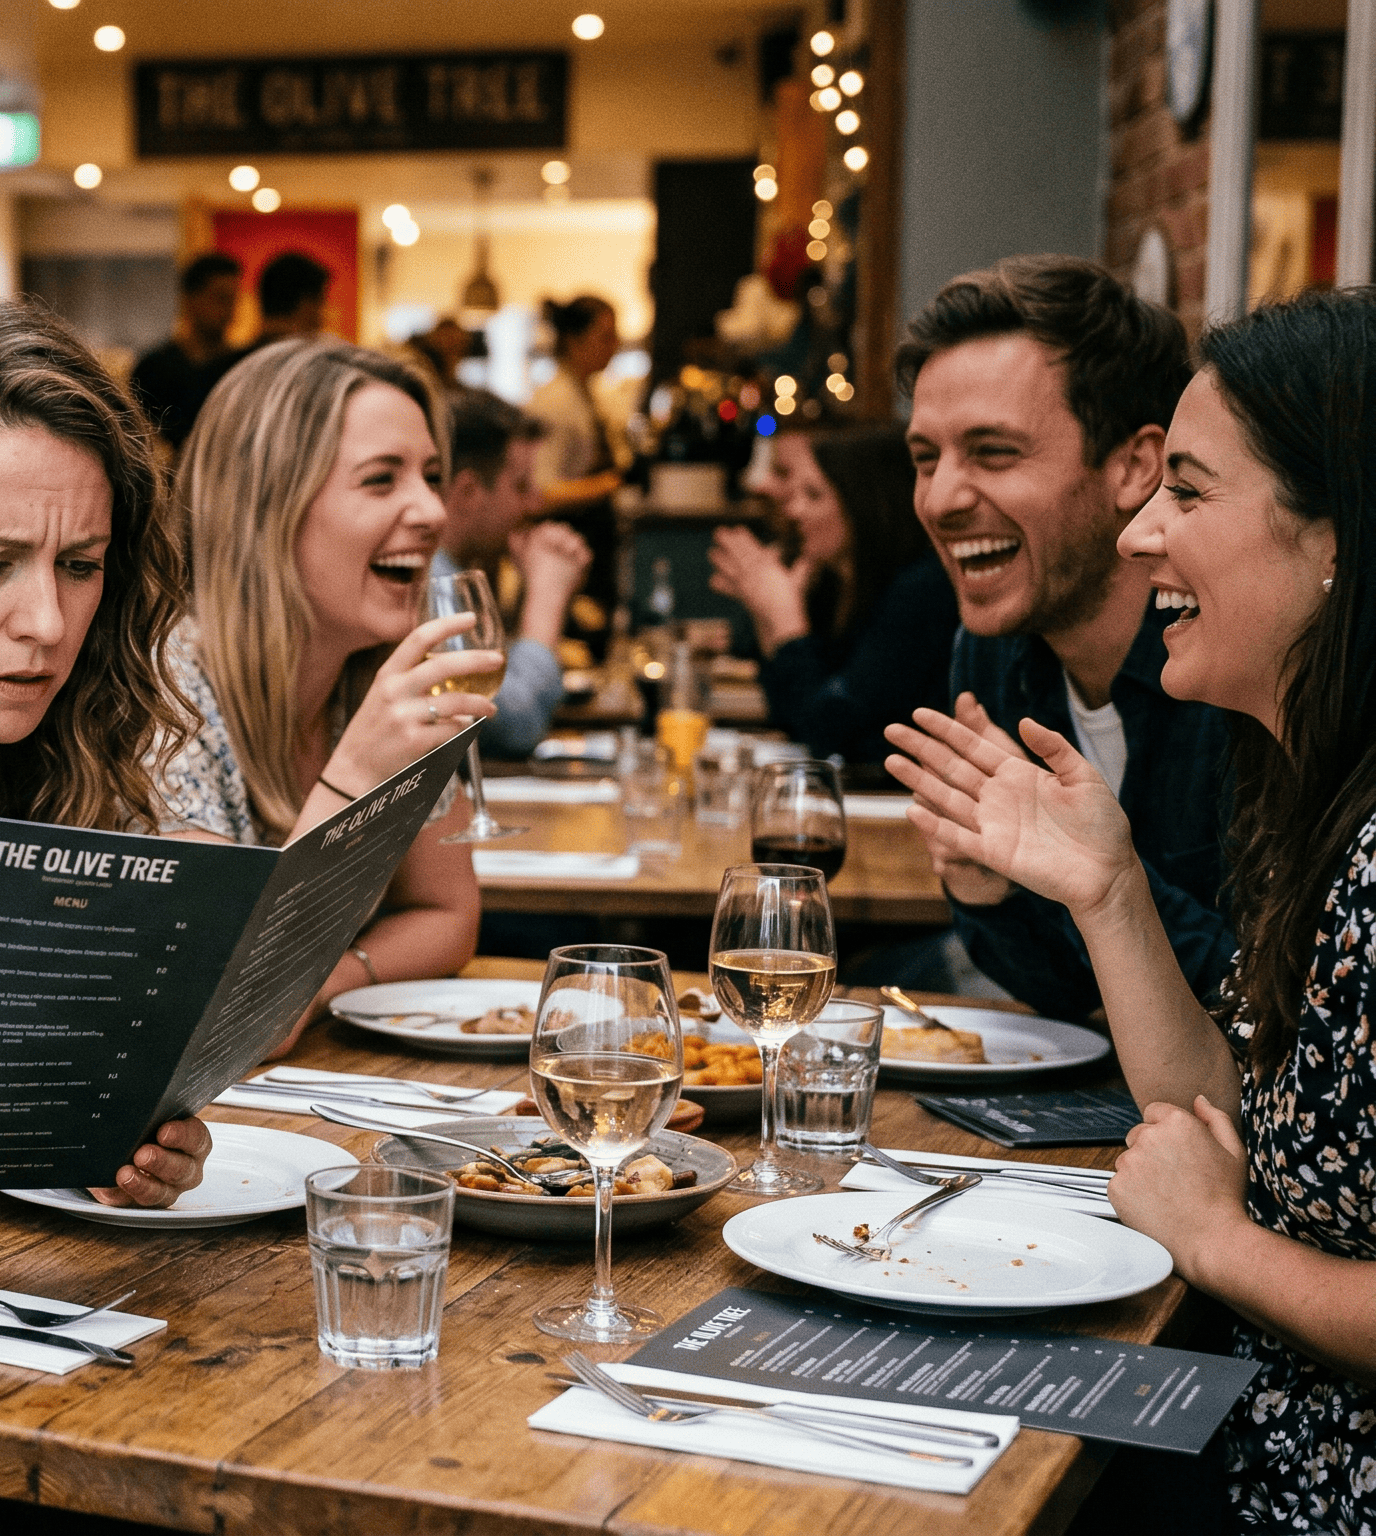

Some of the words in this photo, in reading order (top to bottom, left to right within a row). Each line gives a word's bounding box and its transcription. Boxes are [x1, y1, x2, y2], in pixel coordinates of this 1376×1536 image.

[320, 817, 351, 850] THE
[348, 791, 392, 832] OLIVE
[43, 847, 115, 878] OLIVE
[119, 854, 179, 883] TREE
